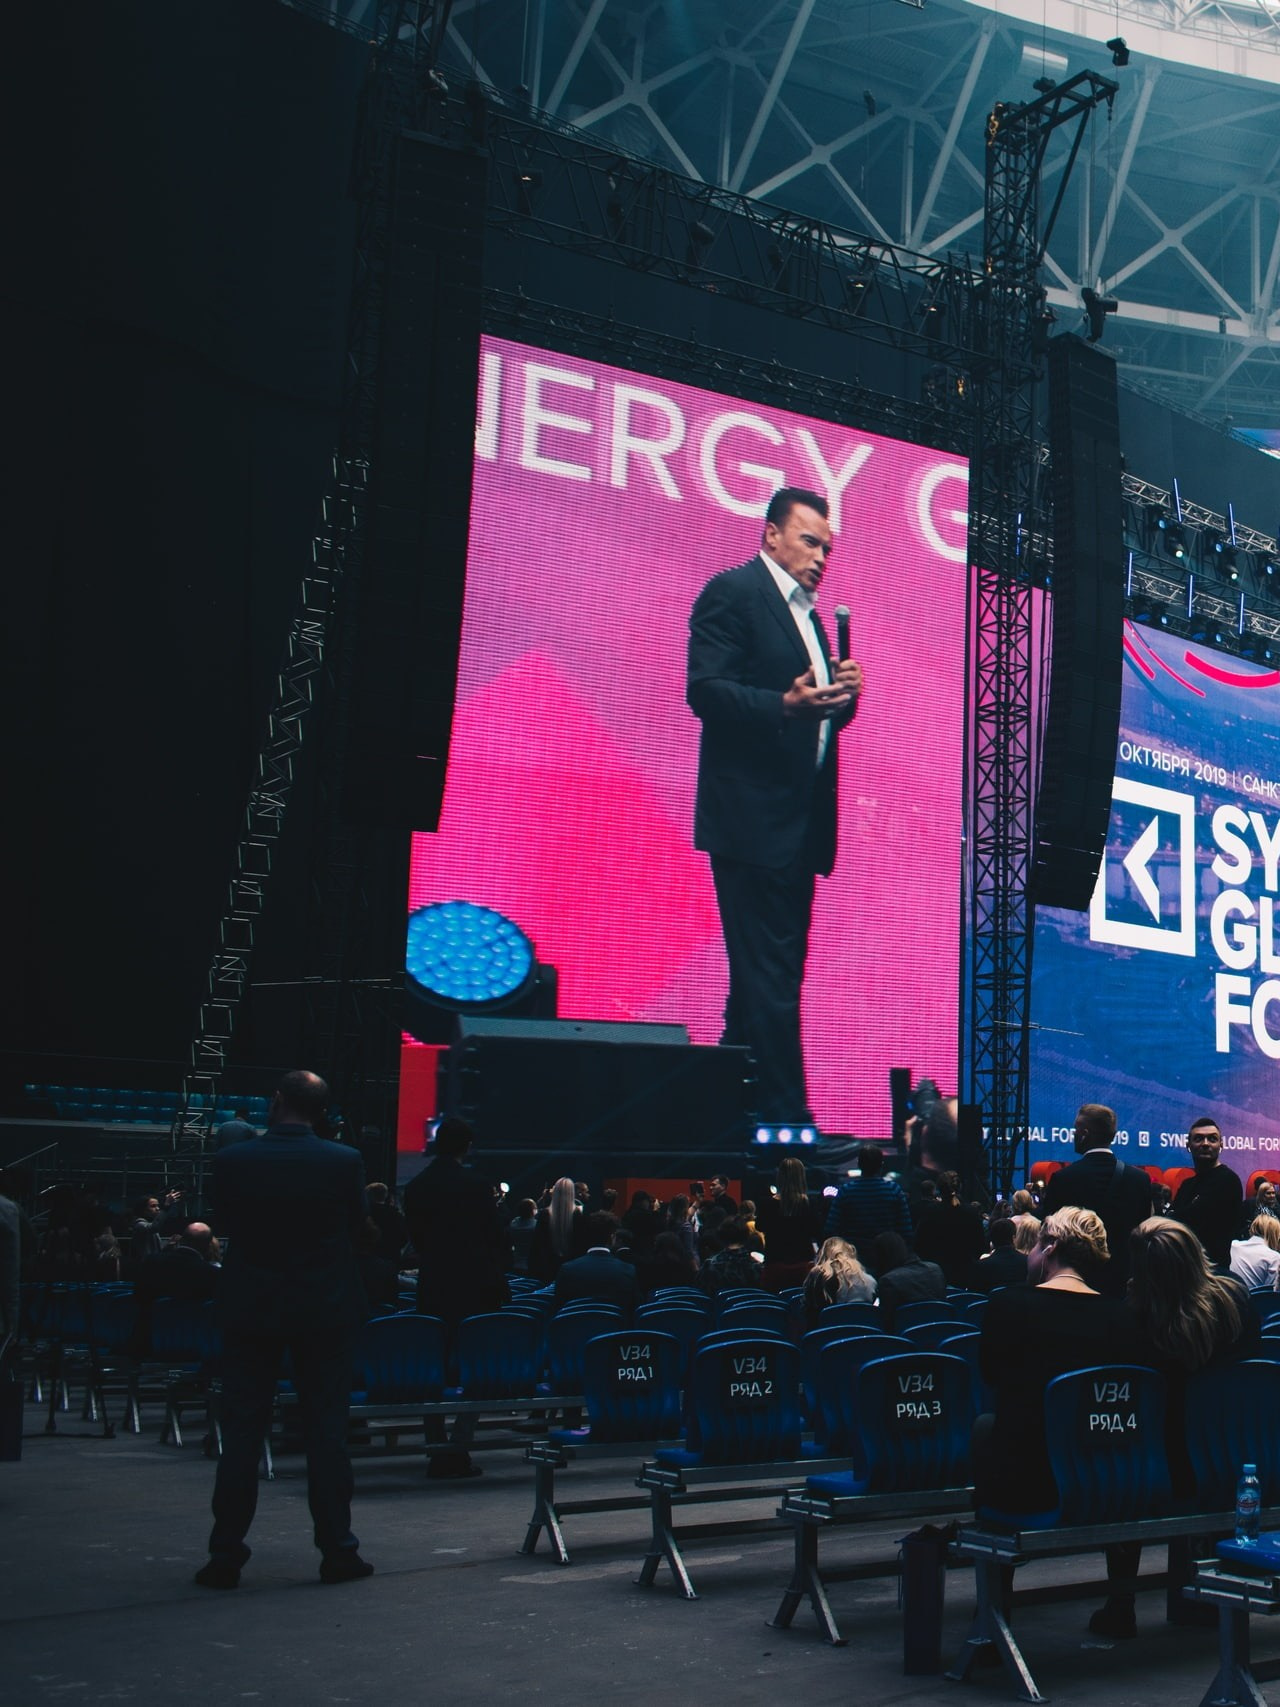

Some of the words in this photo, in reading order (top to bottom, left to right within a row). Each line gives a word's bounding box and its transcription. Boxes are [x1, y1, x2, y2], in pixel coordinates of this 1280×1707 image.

[1119, 742, 1190, 777] ОКТЯБРЯ
[1193, 762, 1228, 787] 2019
[1052, 1127, 1076, 1143] FOR
[1111, 1130, 1129, 1145] 19
[1160, 1132, 1189, 1148] SYNE
[1222, 1136, 1257, 1151] LOBAL
[620, 1345, 651, 1361] V34
[617, 1368, 647, 1381] РЯД
[733, 1357, 767, 1375] V34
[730, 1382, 764, 1398] РЯД
[764, 1381, 773, 1395] 2
[898, 1374, 934, 1393] V34
[1094, 1382, 1131, 1403] V34
[896, 1402, 931, 1419] РЯД
[932, 1400, 942, 1416] 3
[1089, 1413, 1124, 1433] РЯД
[1126, 1413, 1137, 1430] 4
